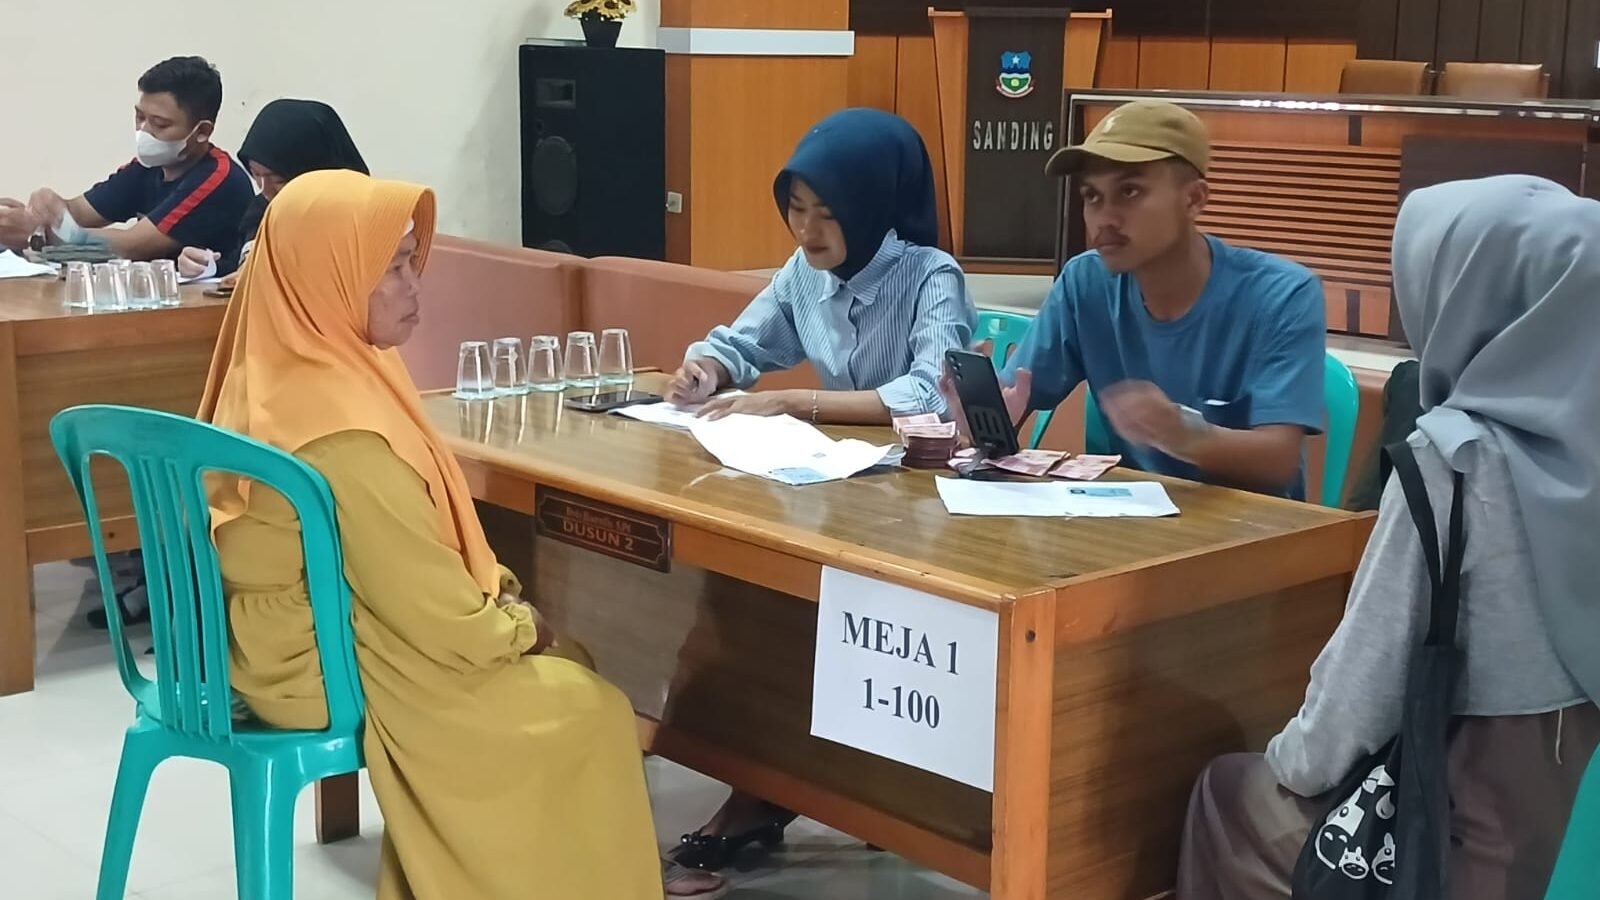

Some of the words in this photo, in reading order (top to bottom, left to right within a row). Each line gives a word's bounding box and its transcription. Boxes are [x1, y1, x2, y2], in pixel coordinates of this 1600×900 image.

[973, 120, 1053, 150] SANDING
[563, 520, 620, 547] DUSUN
[624, 537, 634, 551] 2
[841, 610, 936, 668] MEJA
[947, 641, 959, 675] 1
[862, 678, 940, 729] 1-100
